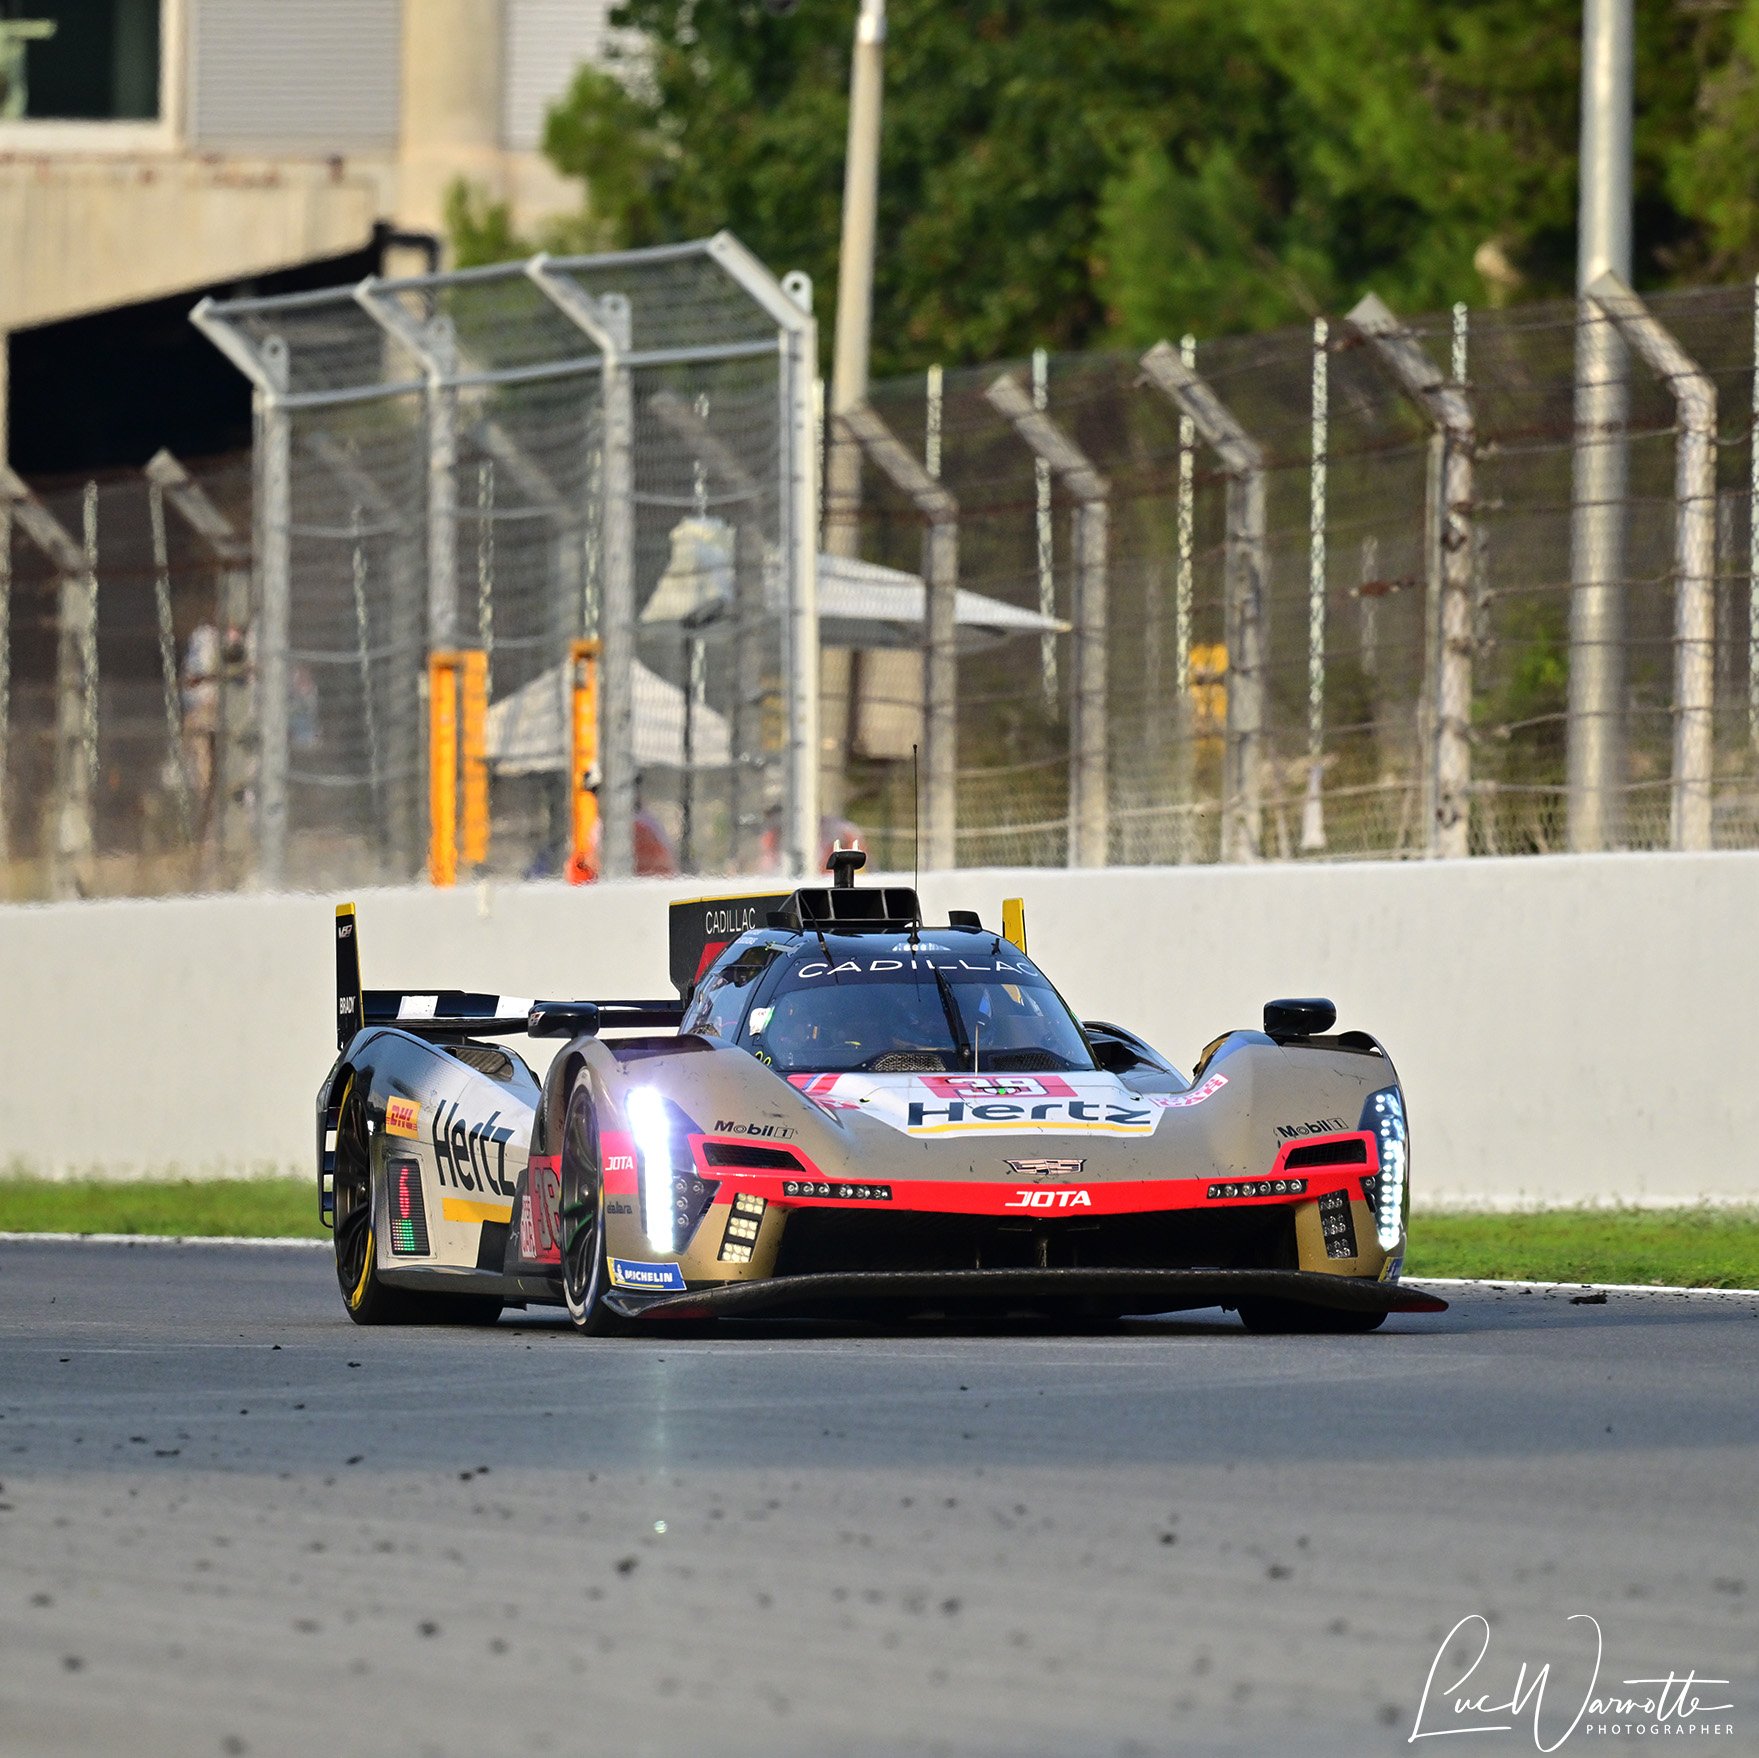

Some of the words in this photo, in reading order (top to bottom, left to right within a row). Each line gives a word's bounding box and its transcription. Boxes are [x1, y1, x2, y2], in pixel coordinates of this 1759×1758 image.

[705, 907, 756, 935] CADILLAC
[798, 959, 1039, 978] CADILLAC
[908, 1100, 1152, 1126] Hertz
[714, 1120, 774, 1137] Mobil
[1276, 1119, 1333, 1138] Mobil
[432, 1099, 517, 1197] Hertz
[605, 1156, 634, 1171] JOTA
[1005, 1190, 1092, 1207] JOTA
[624, 1269, 673, 1283] MICHELIN
